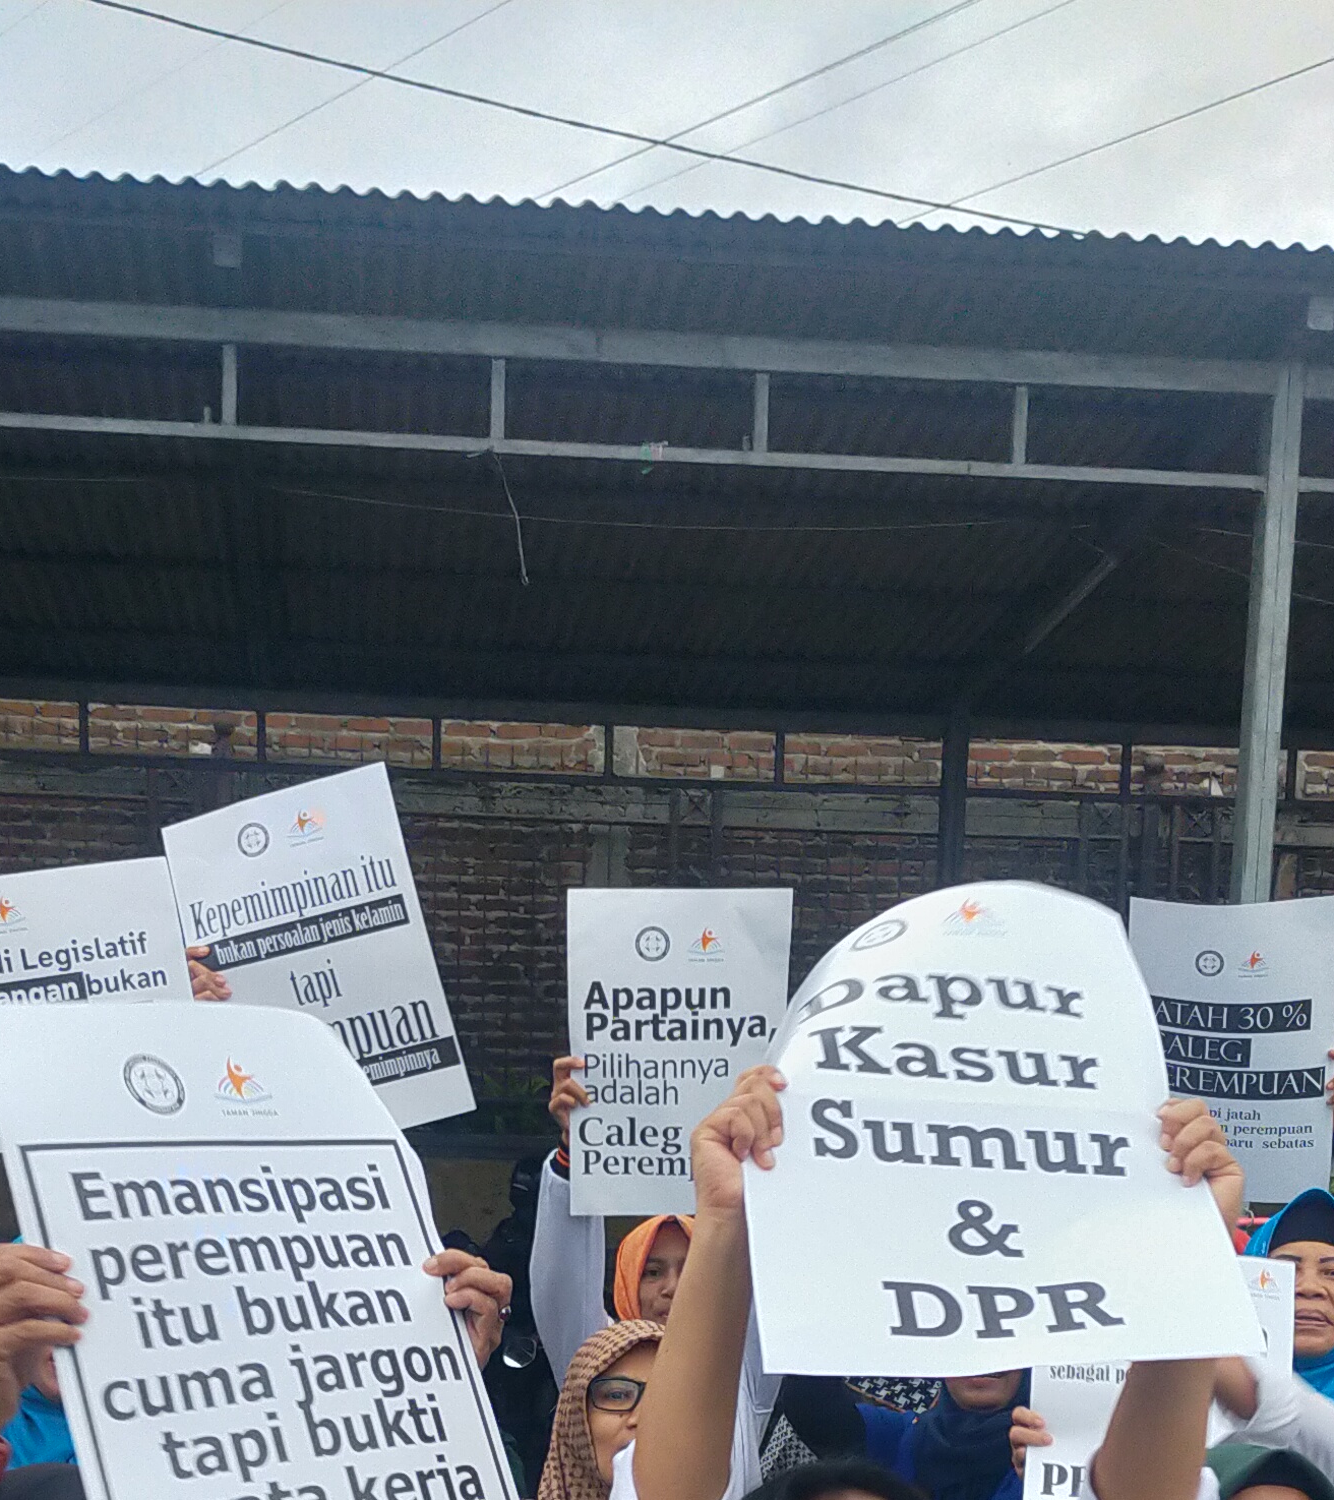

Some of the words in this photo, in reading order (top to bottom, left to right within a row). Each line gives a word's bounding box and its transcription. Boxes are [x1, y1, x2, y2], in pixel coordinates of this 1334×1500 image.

[189, 864, 361, 942] Kepemimpinan
[361, 853, 398, 896] itu
[19, 930, 148, 973] Legislatif
[214, 938, 258, 966] bukan
[258, 921, 321, 960] persoalan
[318, 913, 354, 943] jenis
[354, 899, 406, 933] kelamin
[84, 968, 169, 998] bukan
[289, 958, 344, 1010] tapi
[583, 980, 733, 1018] Apapun
[797, 972, 1085, 1021] Dapur
[585, 1010, 779, 1047] Partainya,
[1155, 1000, 1228, 1029] ATAH
[1238, 1005, 1274, 1030] 30
[1281, 1003, 1308, 1028] %
[583, 1052, 730, 1084] Pilihannya
[808, 1023, 1102, 1091] Kasur
[1161, 1033, 1244, 1063] ALEG
[585, 1080, 680, 1106] adalah
[1225, 1107, 1261, 1121] jatah
[578, 1116, 684, 1154] Caleg
[810, 1098, 1133, 1178] Sumur
[1232, 1124, 1313, 1137] perempuan
[1262, 1138, 1315, 1149] sebatas
[67, 1163, 393, 1224] Emansipasi
[947, 1199, 1025, 1259] &
[90, 1227, 412, 1301] perempuan
[133, 1296, 222, 1351] itu
[234, 1279, 413, 1338] bukan
[881, 1280, 1127, 1340] DPR
[102, 1360, 276, 1423] cuma
[289, 1341, 464, 1404] jargon
[160, 1411, 292, 1483] tapi
[297, 1393, 451, 1461] bukti
